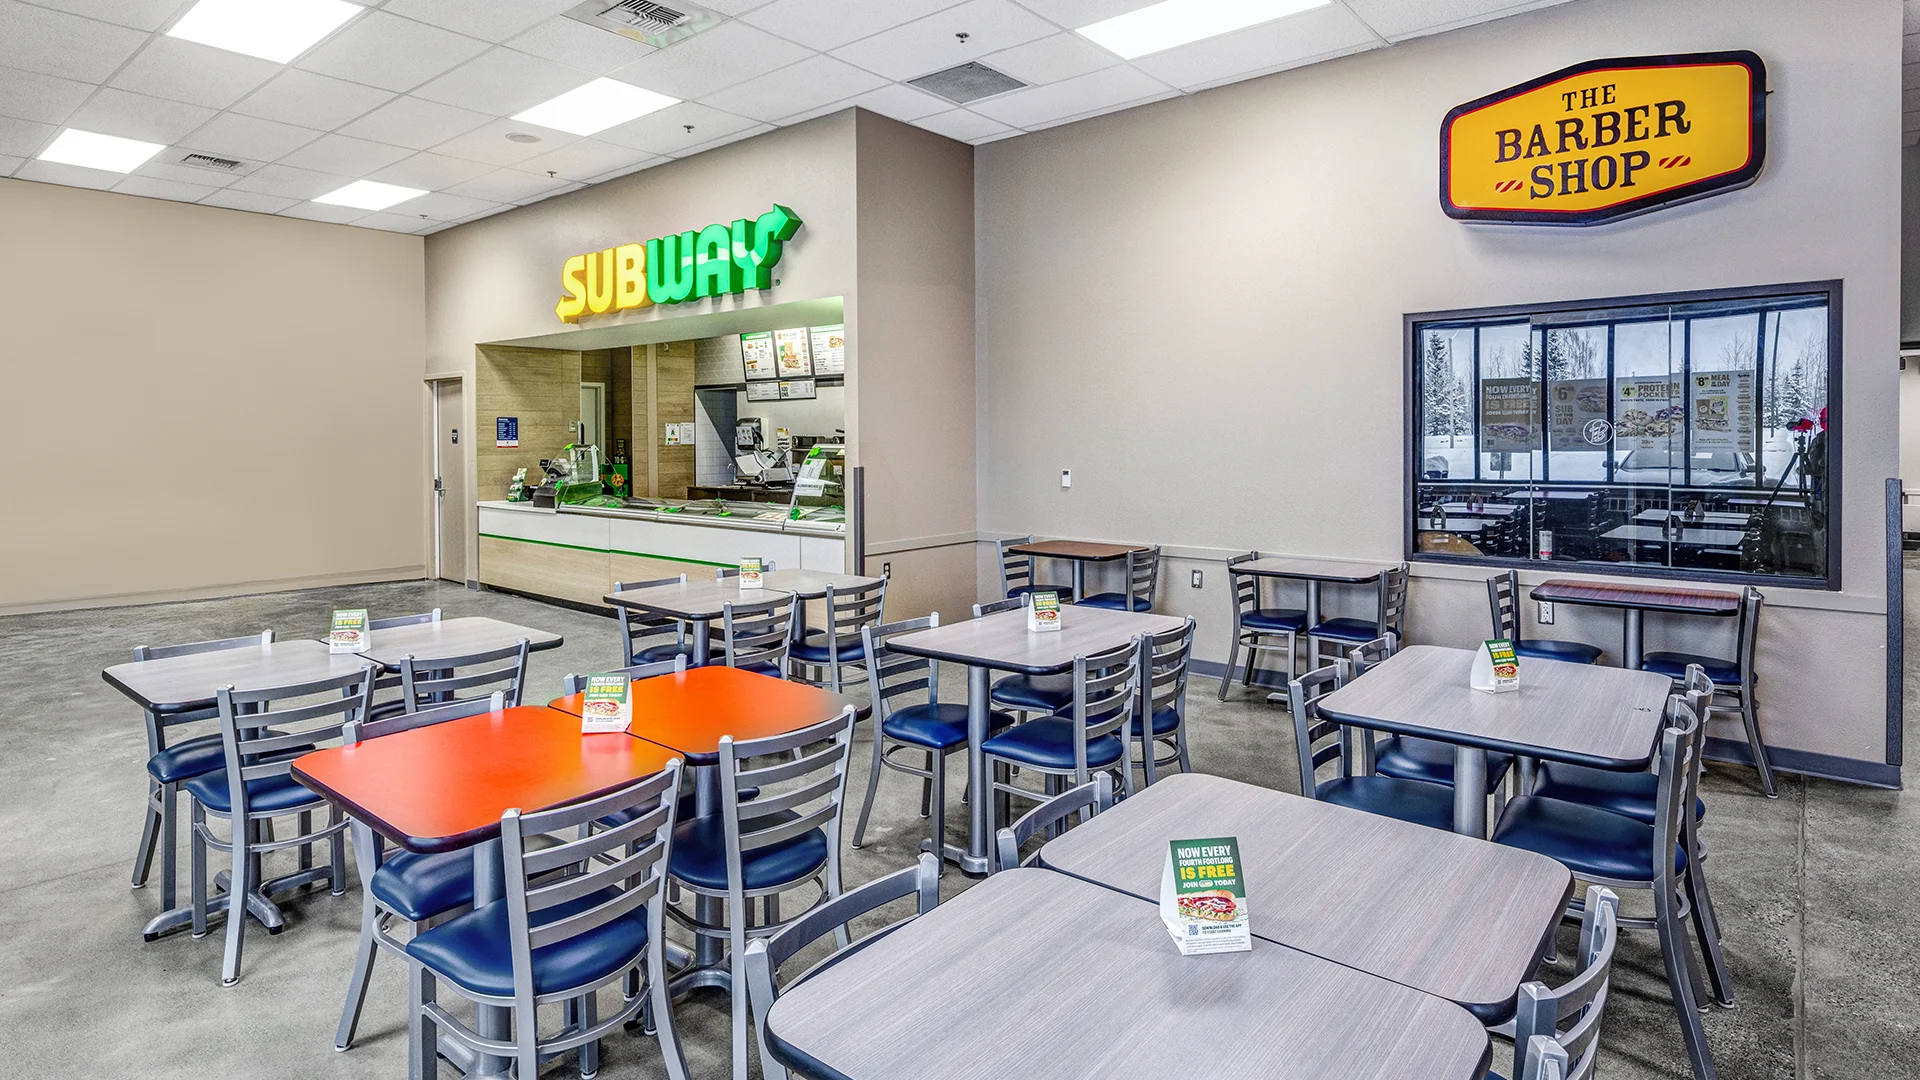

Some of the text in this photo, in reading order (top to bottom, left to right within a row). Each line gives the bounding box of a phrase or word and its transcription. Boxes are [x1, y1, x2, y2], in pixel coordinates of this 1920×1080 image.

[1562, 83, 1616, 112] THE
[1494, 99, 1691, 164] BARBER
[1529, 150, 1651, 200] SHOP
[554, 204, 802, 324] SUBWAY
[1485, 384, 1531, 394] NOW EVERY
[1485, 399, 1530, 409] IS FREE
[1177, 845, 1231, 858] NOW EVERY
[1179, 856, 1234, 867] FOURTH FOOTLONG
[1180, 864, 1236, 880] IS FREE
